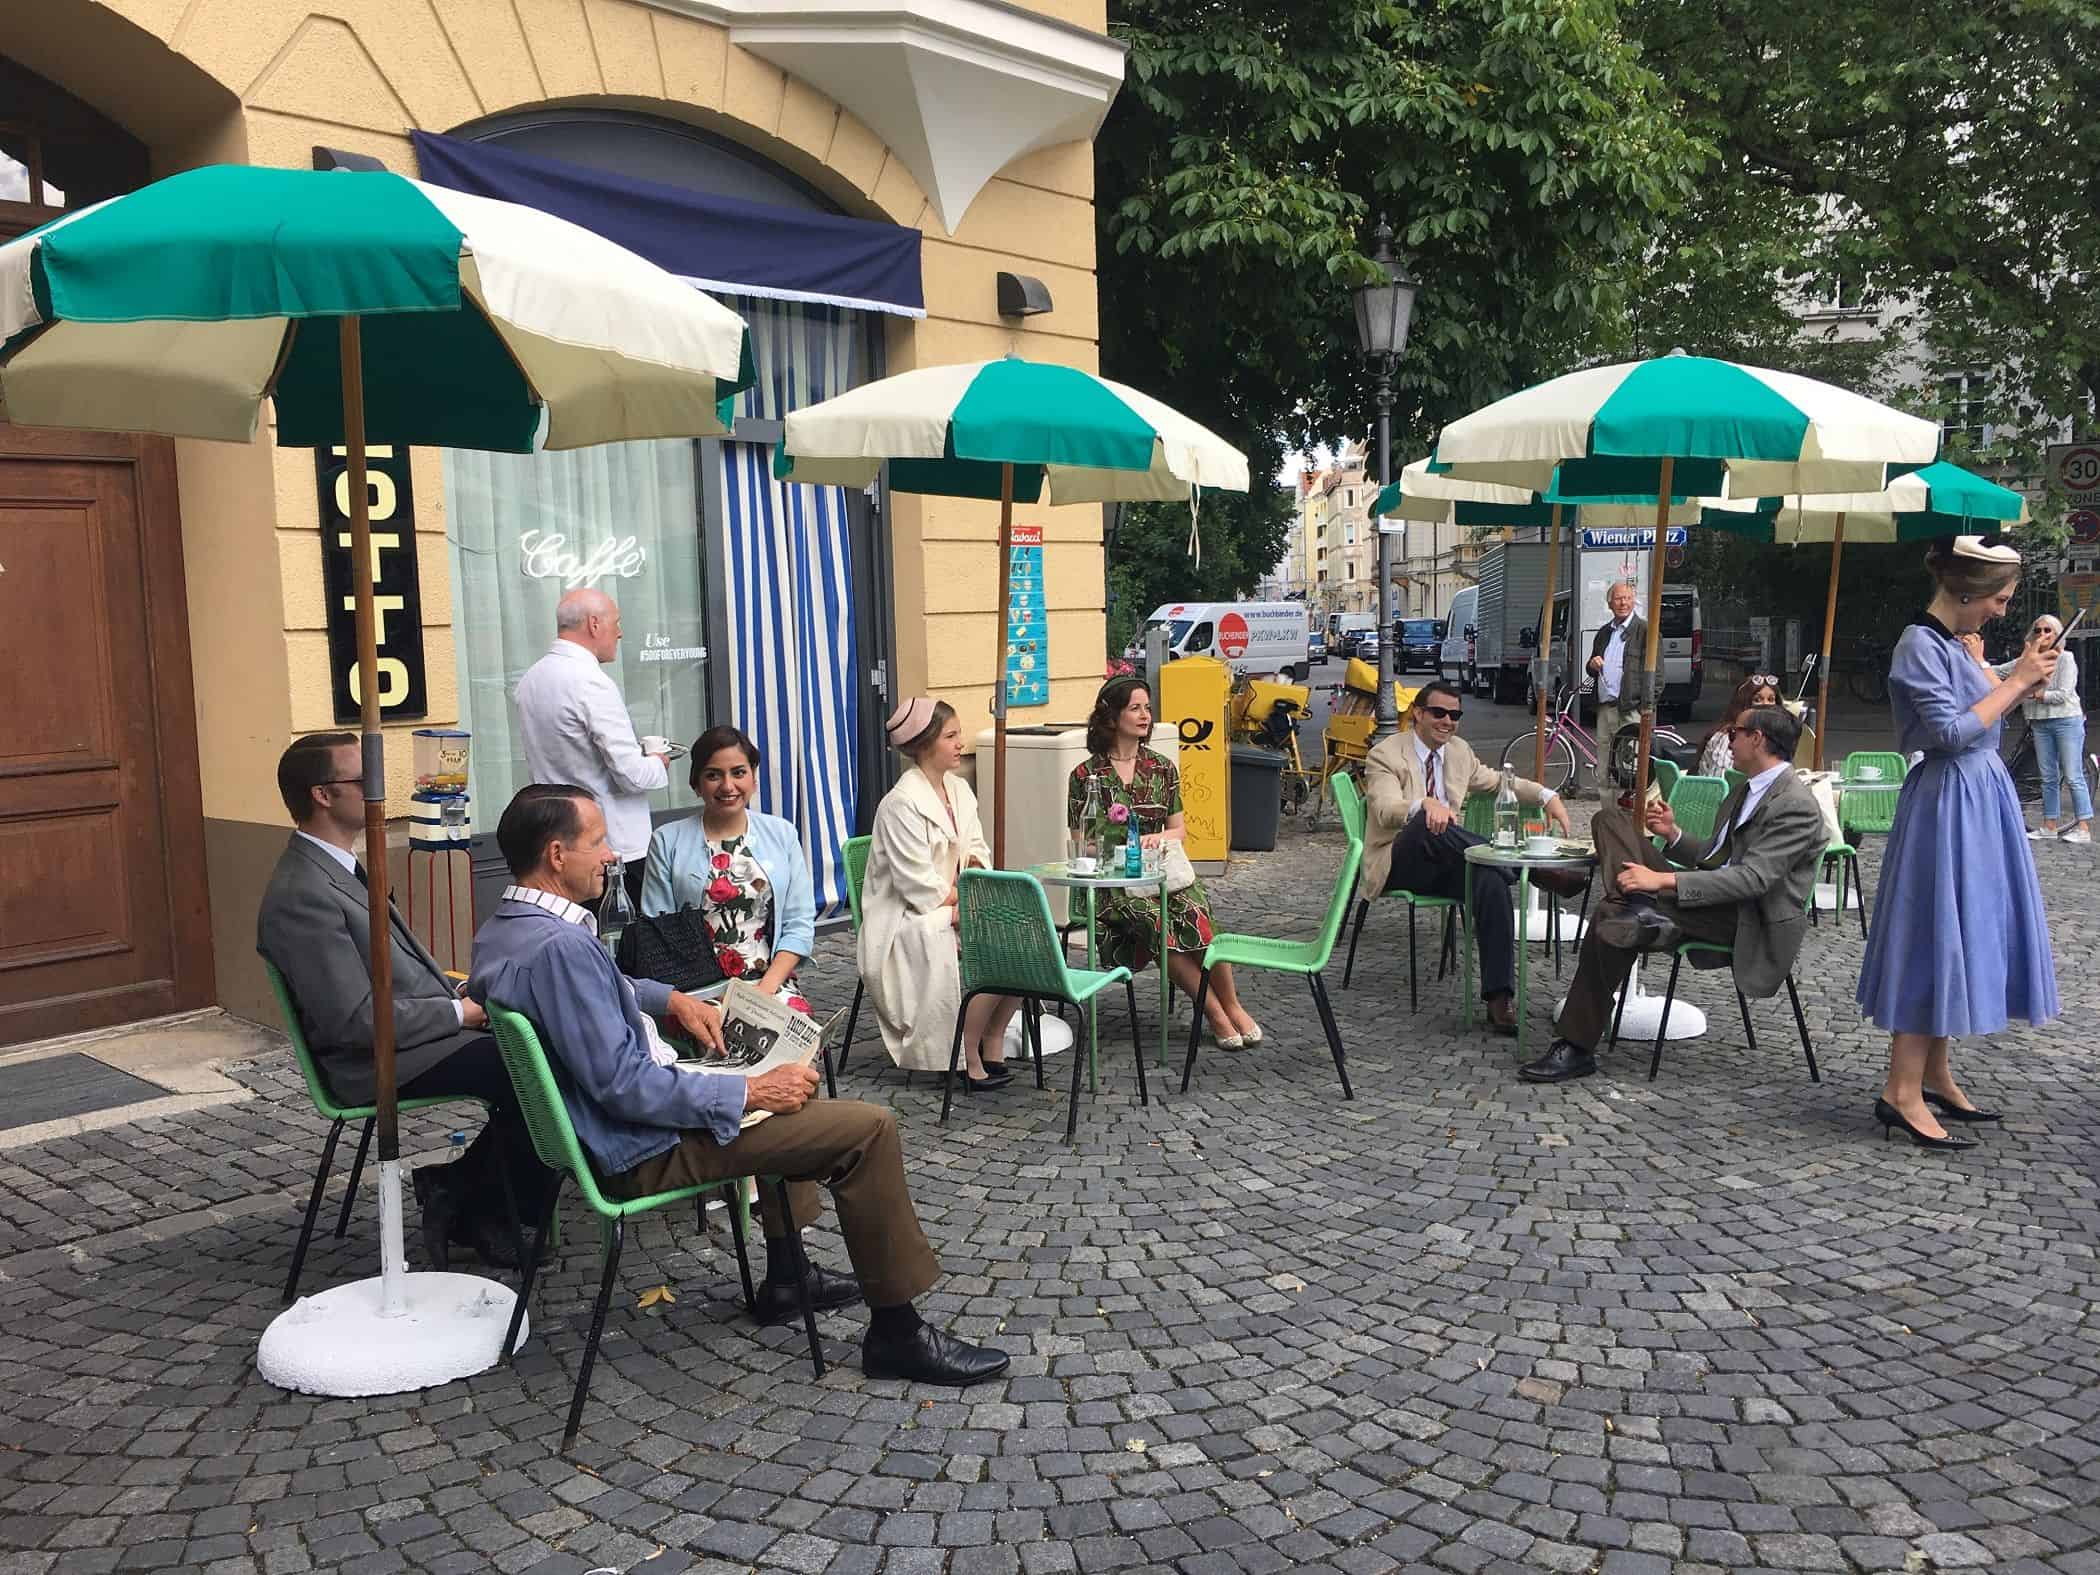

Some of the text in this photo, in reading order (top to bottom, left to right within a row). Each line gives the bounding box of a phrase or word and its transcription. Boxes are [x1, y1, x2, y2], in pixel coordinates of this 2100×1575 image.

[2069, 460, 2097, 480] 30
[1589, 529, 1679, 545] Wiener Pltz
[331, 445, 409, 707] OTTO
[645, 632, 671, 648] Use
